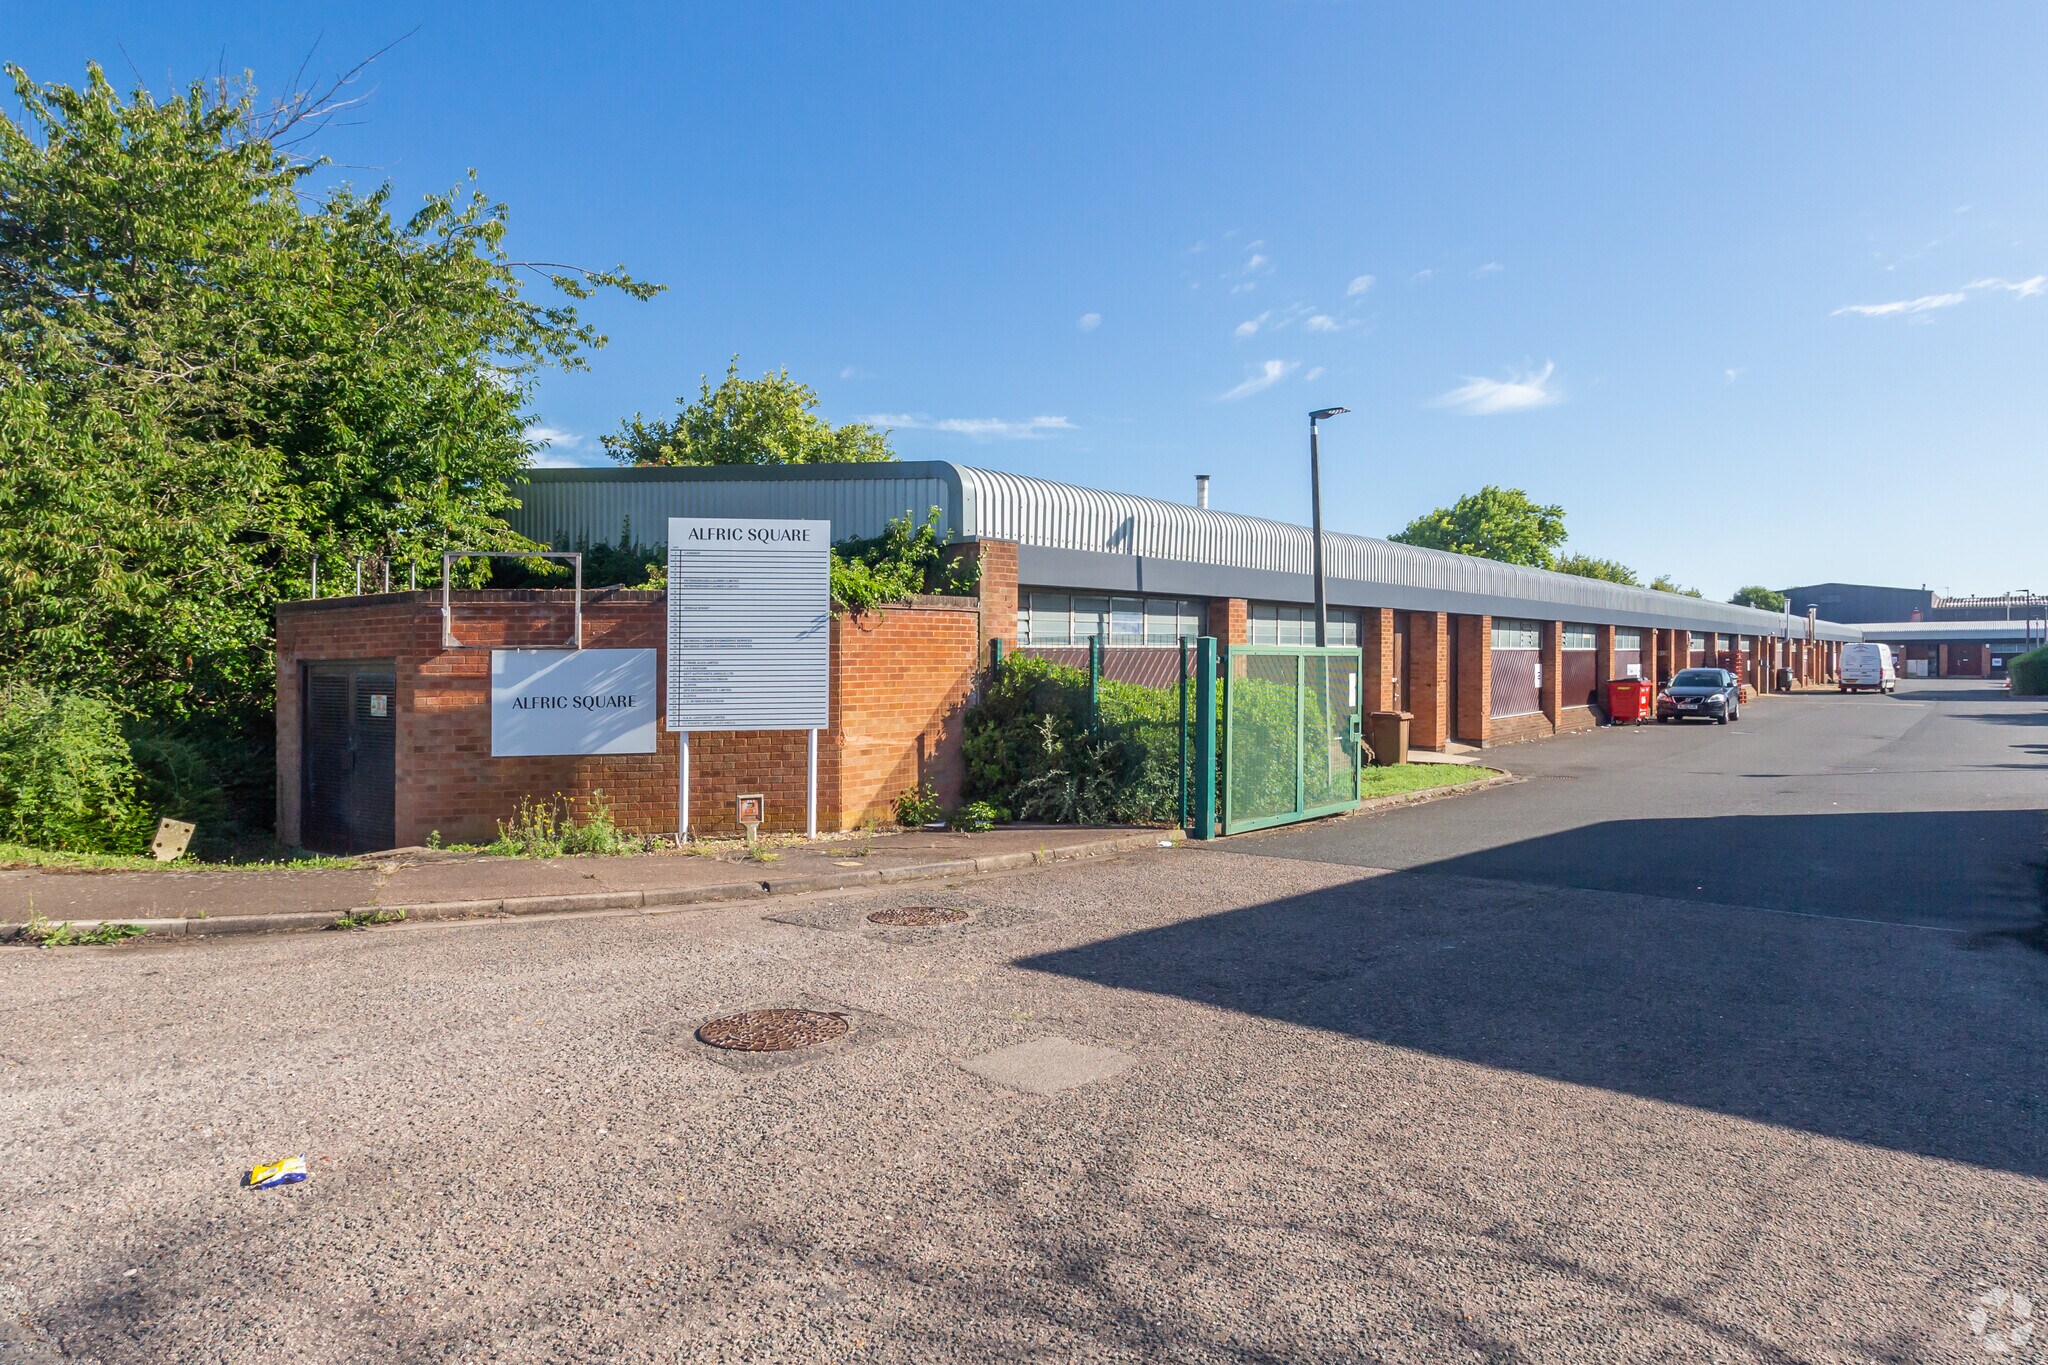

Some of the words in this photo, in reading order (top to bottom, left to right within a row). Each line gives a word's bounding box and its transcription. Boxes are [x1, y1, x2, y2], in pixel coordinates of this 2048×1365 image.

[688, 527, 743, 541] ALFRIC
[747, 528, 811, 545] SQUARE
[512, 696, 568, 710] ALFRIC
[572, 695, 637, 712] SQUARE
